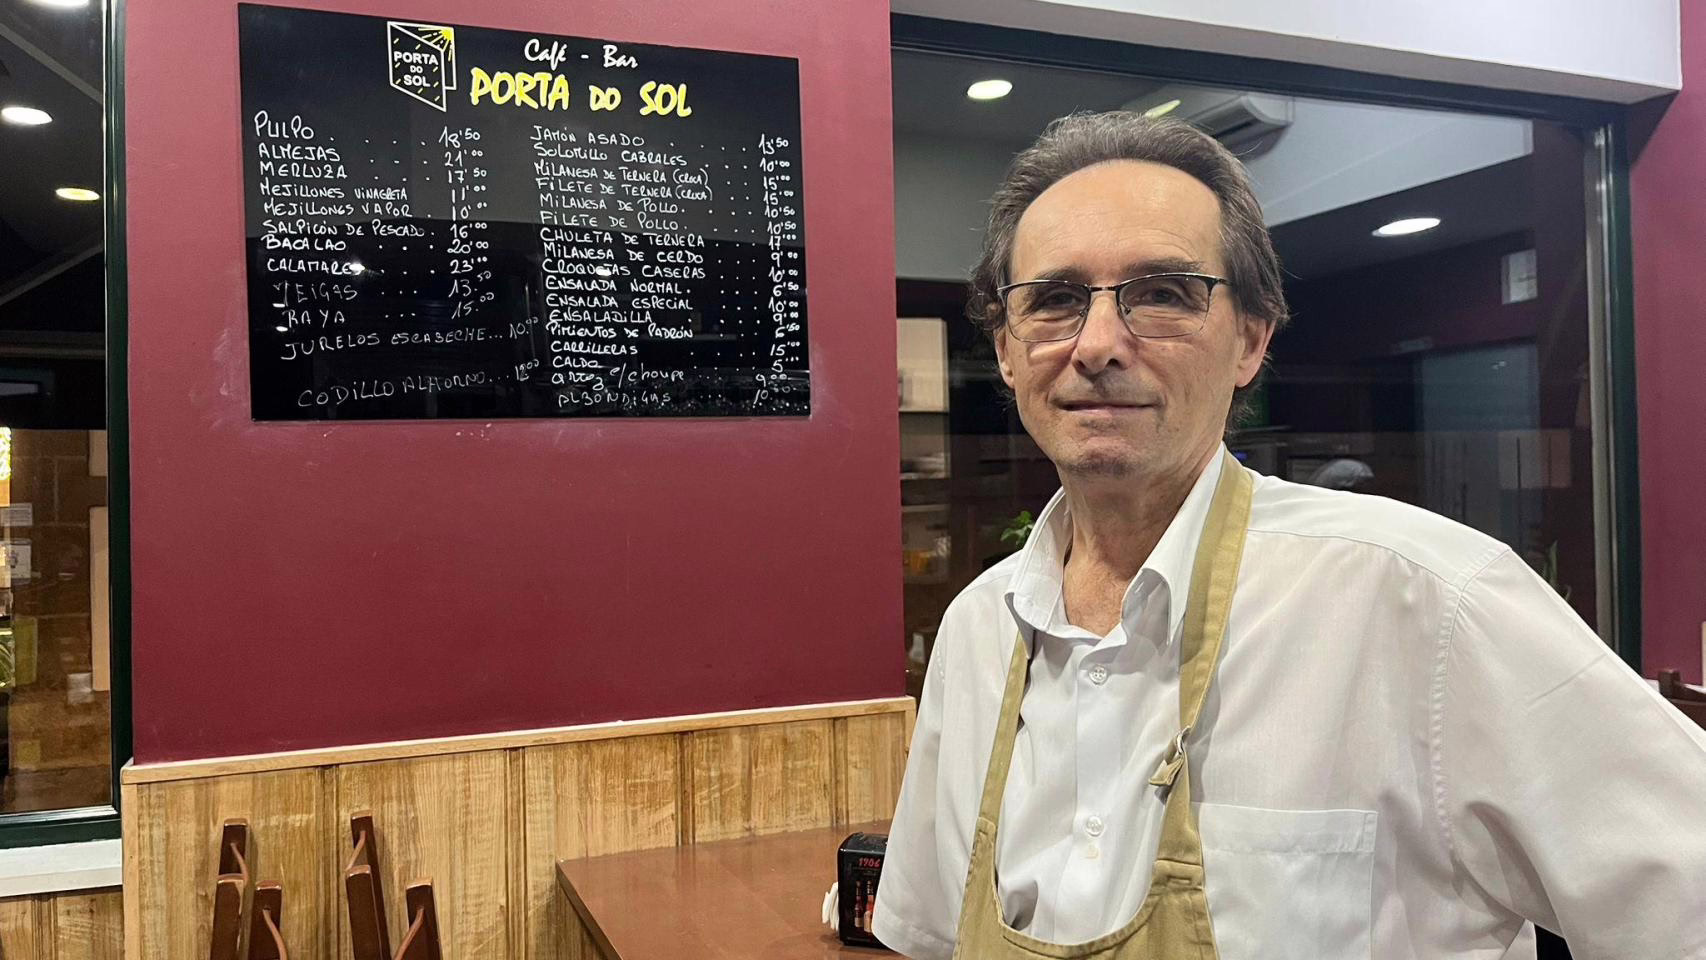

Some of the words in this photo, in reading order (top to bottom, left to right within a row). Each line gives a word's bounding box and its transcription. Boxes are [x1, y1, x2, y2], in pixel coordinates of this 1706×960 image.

[393, 51, 439, 66] PORTA
[524, 38, 568, 71] Café
[603, 44, 639, 69] Bar
[409, 65, 423, 74] DO
[403, 74, 431, 87] SOL
[470, 66, 570, 112] PORTA
[588, 84, 622, 112] DO
[639, 80, 693, 118] SOL
[254, 110, 315, 139] PULPO
[529, 125, 577, 142] JAMÓN
[588, 132, 645, 147] ASADO
[258, 142, 341, 162] ALMEJAS
[533, 142, 608, 161] SOLOMILLO
[621, 149, 688, 167] CABRALES
[259, 160, 348, 179] MERLUZA
[534, 158, 598, 178] MILANESA
[603, 169, 617, 180] DE
[618, 166, 667, 183] TERNERA
[259, 176, 345, 199] MEJILLONES
[535, 177, 593, 192] FILETE
[599, 182, 616, 195] DE
[620, 184, 673, 199] TERNERA
[263, 197, 355, 216] MEJILLONES
[361, 201, 413, 217] VAPOR
[539, 192, 608, 210] MILANESA
[616, 199, 634, 213] DE
[636, 197, 679, 214] POLLO
[262, 219, 338, 235] SALPICÓN
[345, 222, 365, 236] DE
[371, 218, 425, 237] PESCADO
[539, 210, 599, 227] FILETE
[608, 215, 628, 229] DE
[637, 211, 679, 231] POLLO
[260, 233, 347, 251] BACALAO
[539, 226, 614, 244] CHULETA
[620, 232, 640, 245] DE
[642, 232, 705, 248] TERNERA
[543, 242, 615, 260] MILANESA
[626, 249, 645, 262] DE
[656, 249, 704, 263] CERDO
[641, 264, 706, 279] CASERAS
[545, 275, 617, 292] ENSALADA
[630, 279, 682, 294] NORMAL
[545, 293, 619, 309] ENSALADA
[631, 297, 694, 310] ESPECIAL
[281, 308, 345, 329] RAYA
[549, 307, 653, 323] ENSALADILLA
[545, 321, 617, 339] PIMIENTOS
[623, 327, 640, 339] DE
[647, 322, 694, 340] PADRÓN
[280, 332, 380, 360] JURELOS
[550, 340, 639, 356] CARRILLERAS
[552, 355, 600, 368] CALDO
[297, 379, 395, 407] CODILLO
